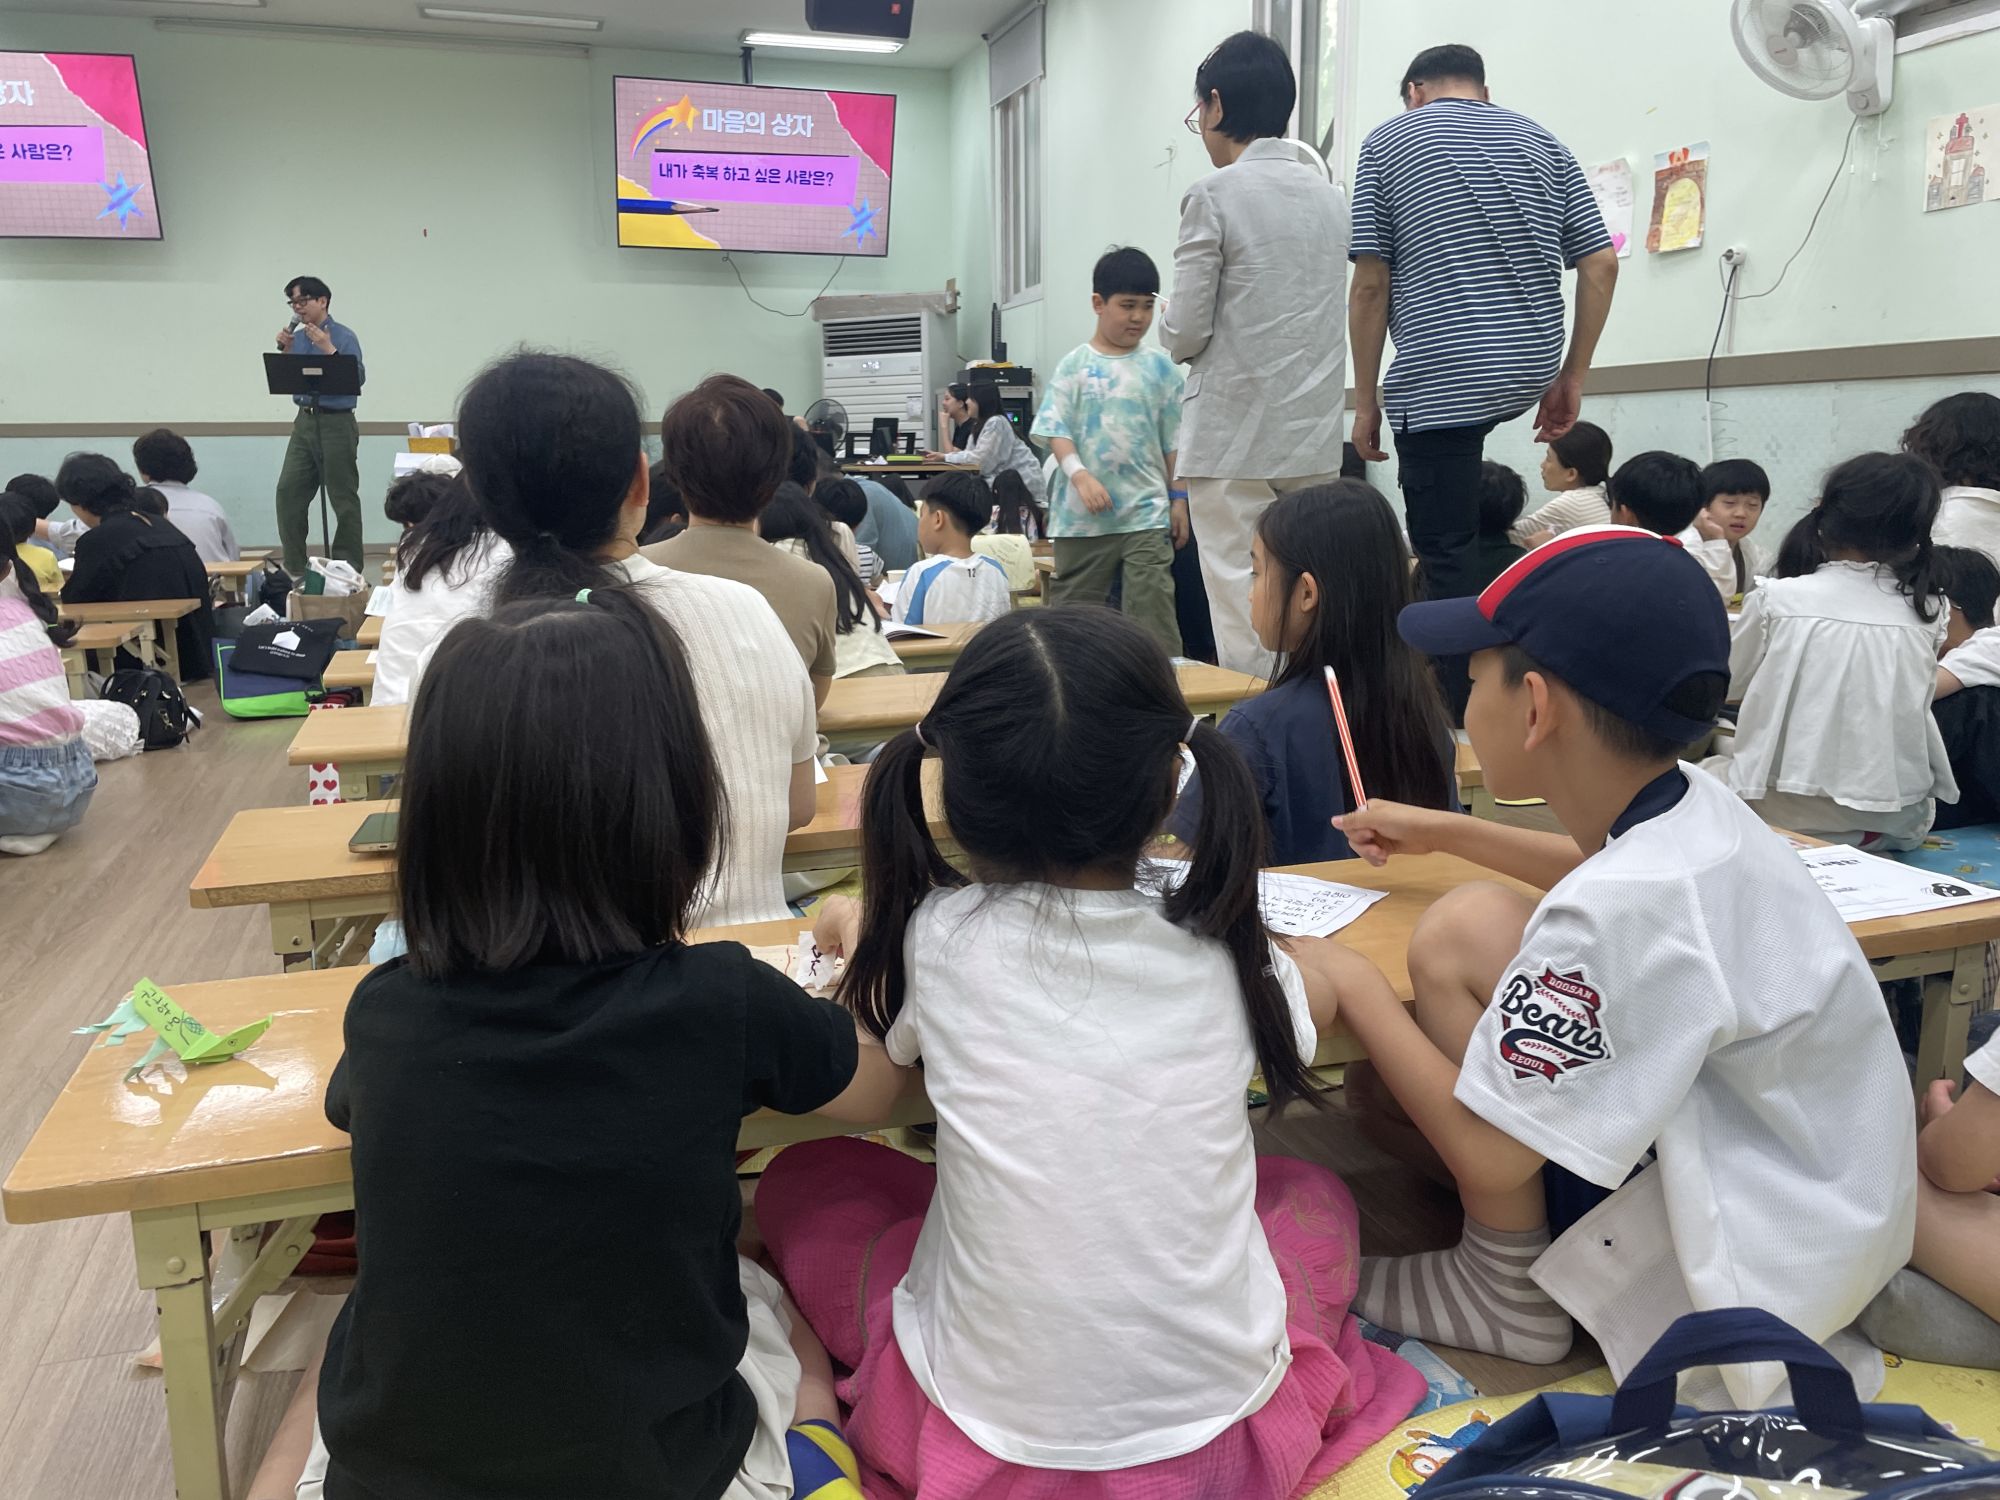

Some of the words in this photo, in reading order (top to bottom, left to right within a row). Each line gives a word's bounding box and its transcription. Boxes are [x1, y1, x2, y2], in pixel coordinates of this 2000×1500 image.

[0, 79, 34, 106] 자
[702, 109, 766, 135] 마음의
[770, 112, 815, 138] 상자
[11, 143, 73, 161] 사람은?
[659, 163, 687, 179] 내가
[692, 164, 719, 181] 축복
[723, 165, 751, 182] 하고
[755, 168, 781, 184] 싶은
[785, 169, 834, 187] 사람은?
[967, 567, 977, 578] 12
[1547, 976, 1593, 1000] DOOSAN
[1499, 974, 1605, 1053] Bears
[1508, 1052, 1546, 1072] SEOUL
